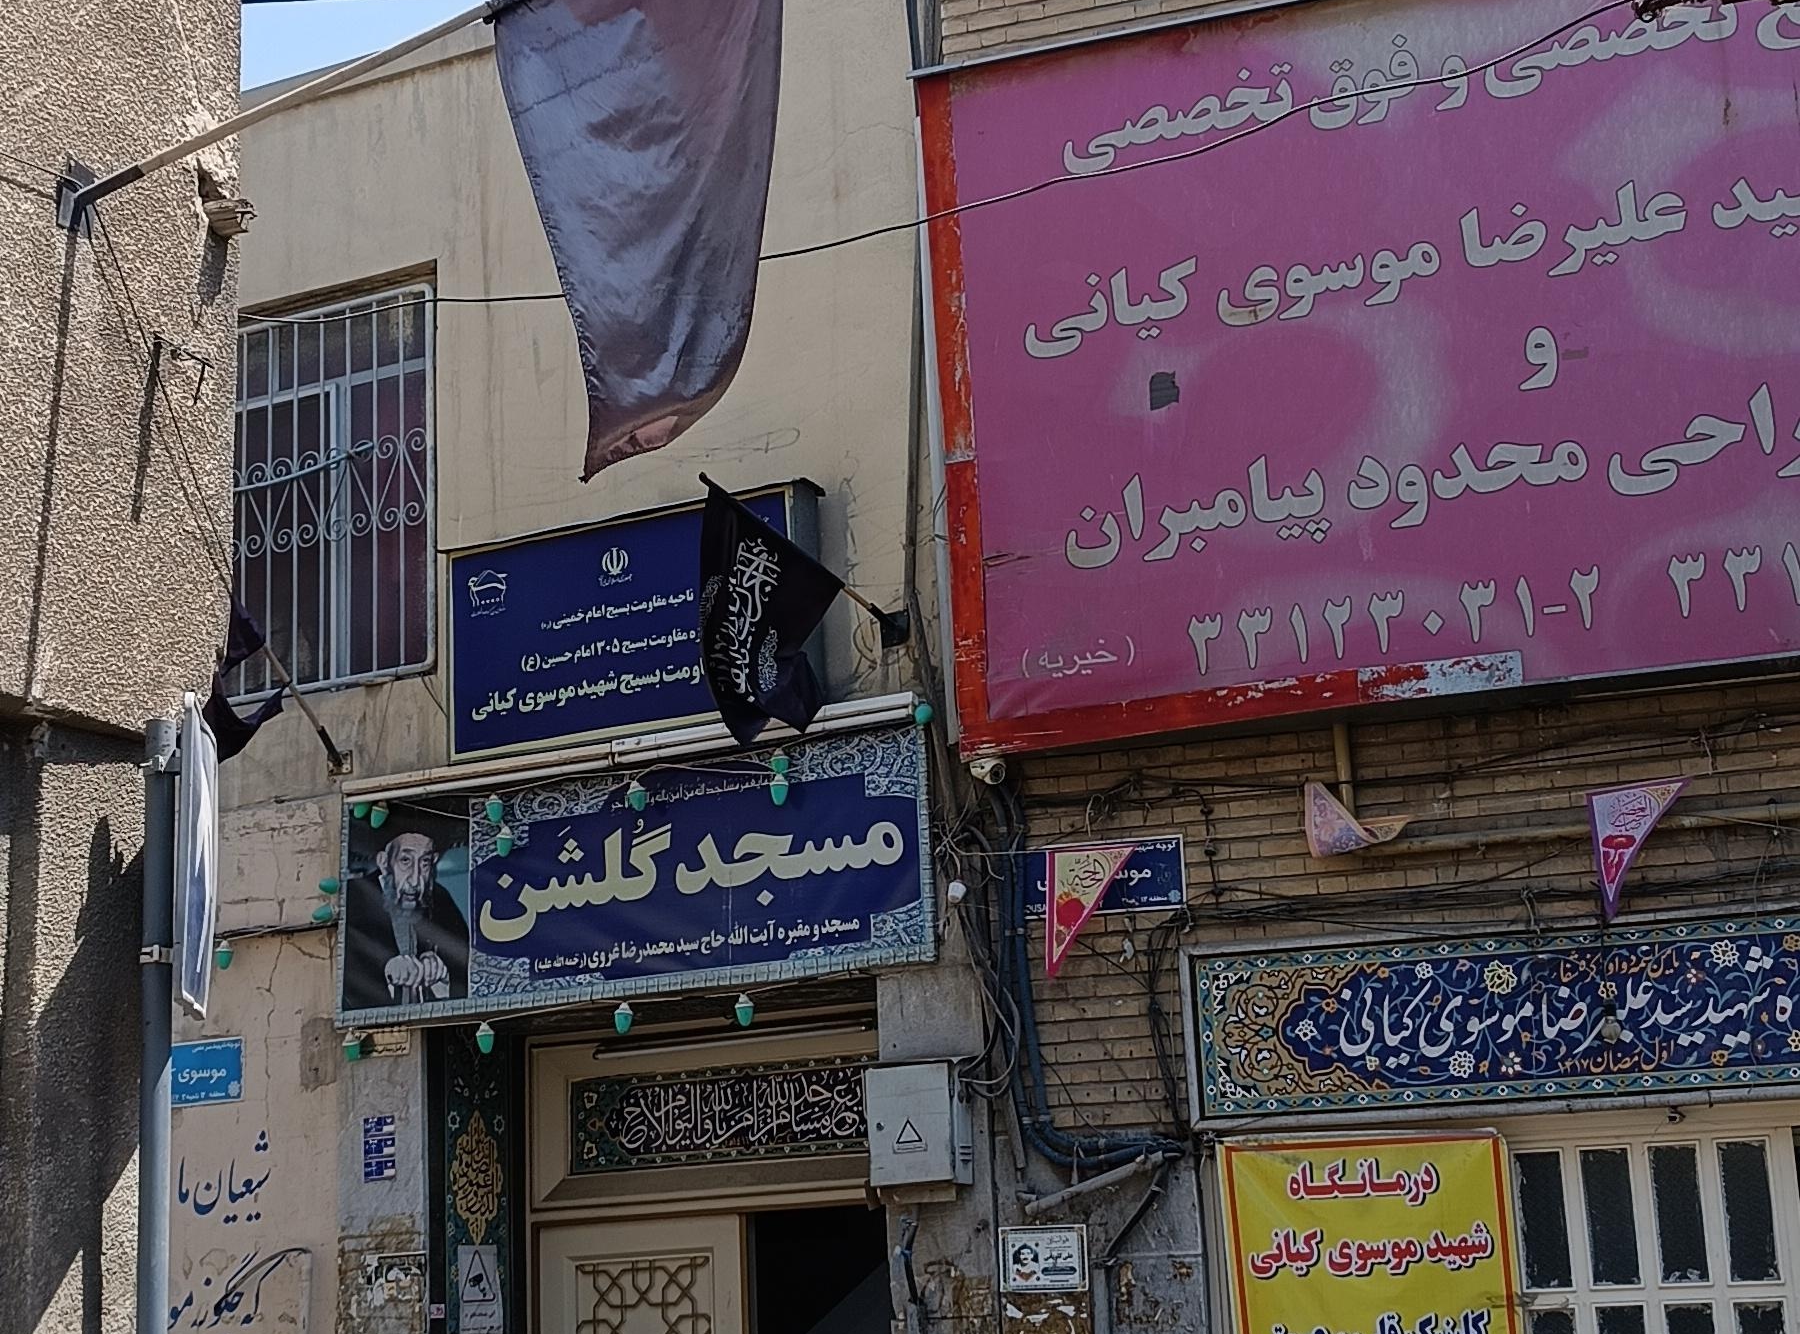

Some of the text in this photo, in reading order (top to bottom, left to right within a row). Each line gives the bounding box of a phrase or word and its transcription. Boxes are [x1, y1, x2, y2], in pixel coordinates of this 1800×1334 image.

[1309, 36, 1421, 131] فوق
[1436, 50, 1467, 111] و
[1062, 60, 1295, 177] تخصصی
[1460, 180, 1687, 276] علیرضا
[1216, 241, 1441, 327] موسوی
[1023, 257, 1197, 360] کیانی
[1518, 326, 1561, 391] و
[1346, 435, 1589, 528] محدود
[1063, 456, 1331, 570] پیامبران
[606, 602, 630, 619] بسیج
[631, 594, 667, 614] مقاومت
[668, 588, 694, 608] ناحیه
[552, 608, 585, 630] خمینی
[585, 604, 605, 623] امام
[596, 638, 620, 656] ۳۰۵
[621, 637, 648, 654] بسیج
[649, 628, 688, 648] مقاومت
[520, 653, 541, 672] (ع)
[541, 651, 573, 668] حسین
[574, 643, 595, 663] امام
[577, 670, 618, 699] شهید
[619, 667, 660, 694] بسیج
[471, 689, 517, 721] کیانی
[518, 685, 576, 713] موسوی
[675, 817, 904, 907] مسجد
[728, 920, 749, 945] الله
[778, 919, 811, 946] مقبره
[812, 922, 820, 942] و
[821, 916, 860, 937] مسجد
[677, 938, 700, 957] سید
[701, 929, 726, 955] حاج
[588, 944, 620, 970] غروی
[1692, 946, 1774, 1047] شهید
[1337, 980, 1432, 1069] کیانی
[1420, 1002, 1534, 1058] موسوی
[1640, 987, 1706, 1047] سید
[178, 1068, 227, 1085] موسوی
[178, 1155, 190, 1204] ما
[1290, 1159, 1436, 1204] درمانگاه
[1251, 1224, 1490, 1276] شهید موسوی کیانی
